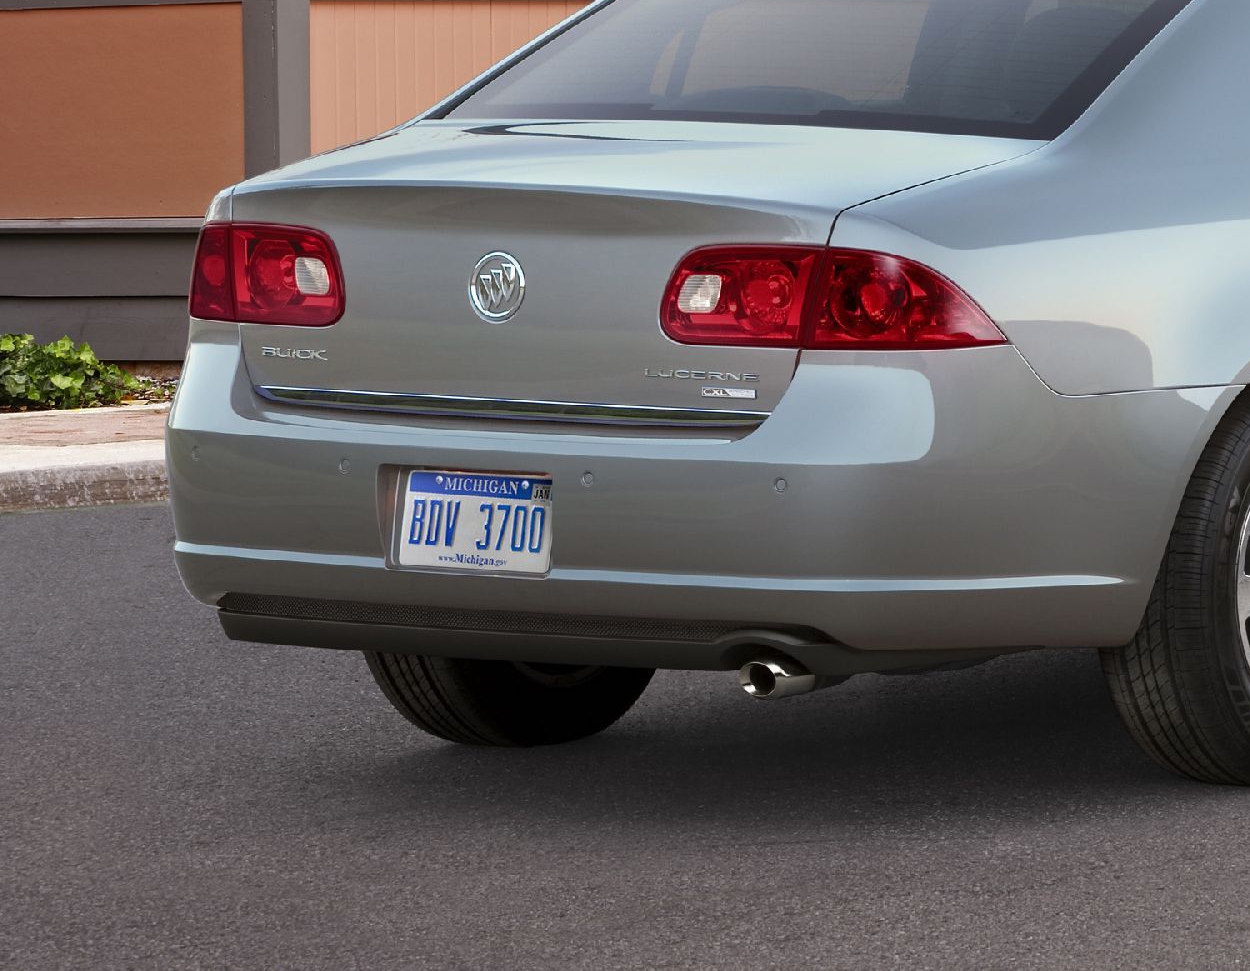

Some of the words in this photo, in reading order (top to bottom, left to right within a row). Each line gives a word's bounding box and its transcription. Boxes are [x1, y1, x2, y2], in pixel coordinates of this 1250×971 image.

[261, 346, 328, 361] BUICK
[644, 368, 760, 382] LUCERNE
[702, 388, 731, 397] CXL
[444, 476, 520, 495] MICHIGAN
[533, 488, 550, 501] JAN
[408, 498, 461, 547] BDV
[475, 502, 545, 553] 3700
[438, 552, 508, 567] www.Michigan.gov
